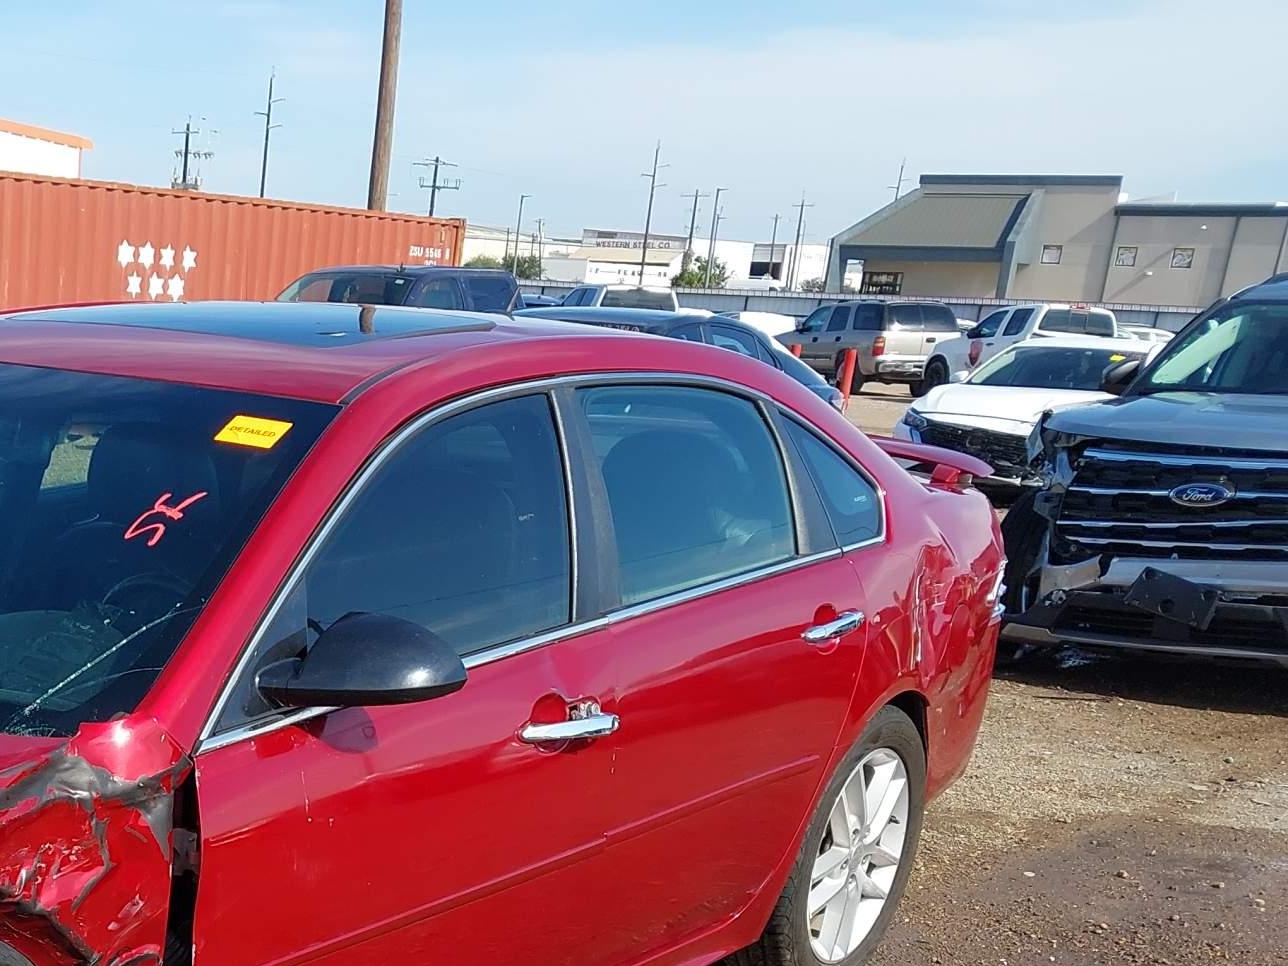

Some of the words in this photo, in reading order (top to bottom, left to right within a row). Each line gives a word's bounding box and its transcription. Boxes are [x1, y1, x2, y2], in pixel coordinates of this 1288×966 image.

[595, 240, 631, 249] WESTERN
[229, 425, 276, 437] DETAILED
[1183, 487, 1216, 502] Ford
